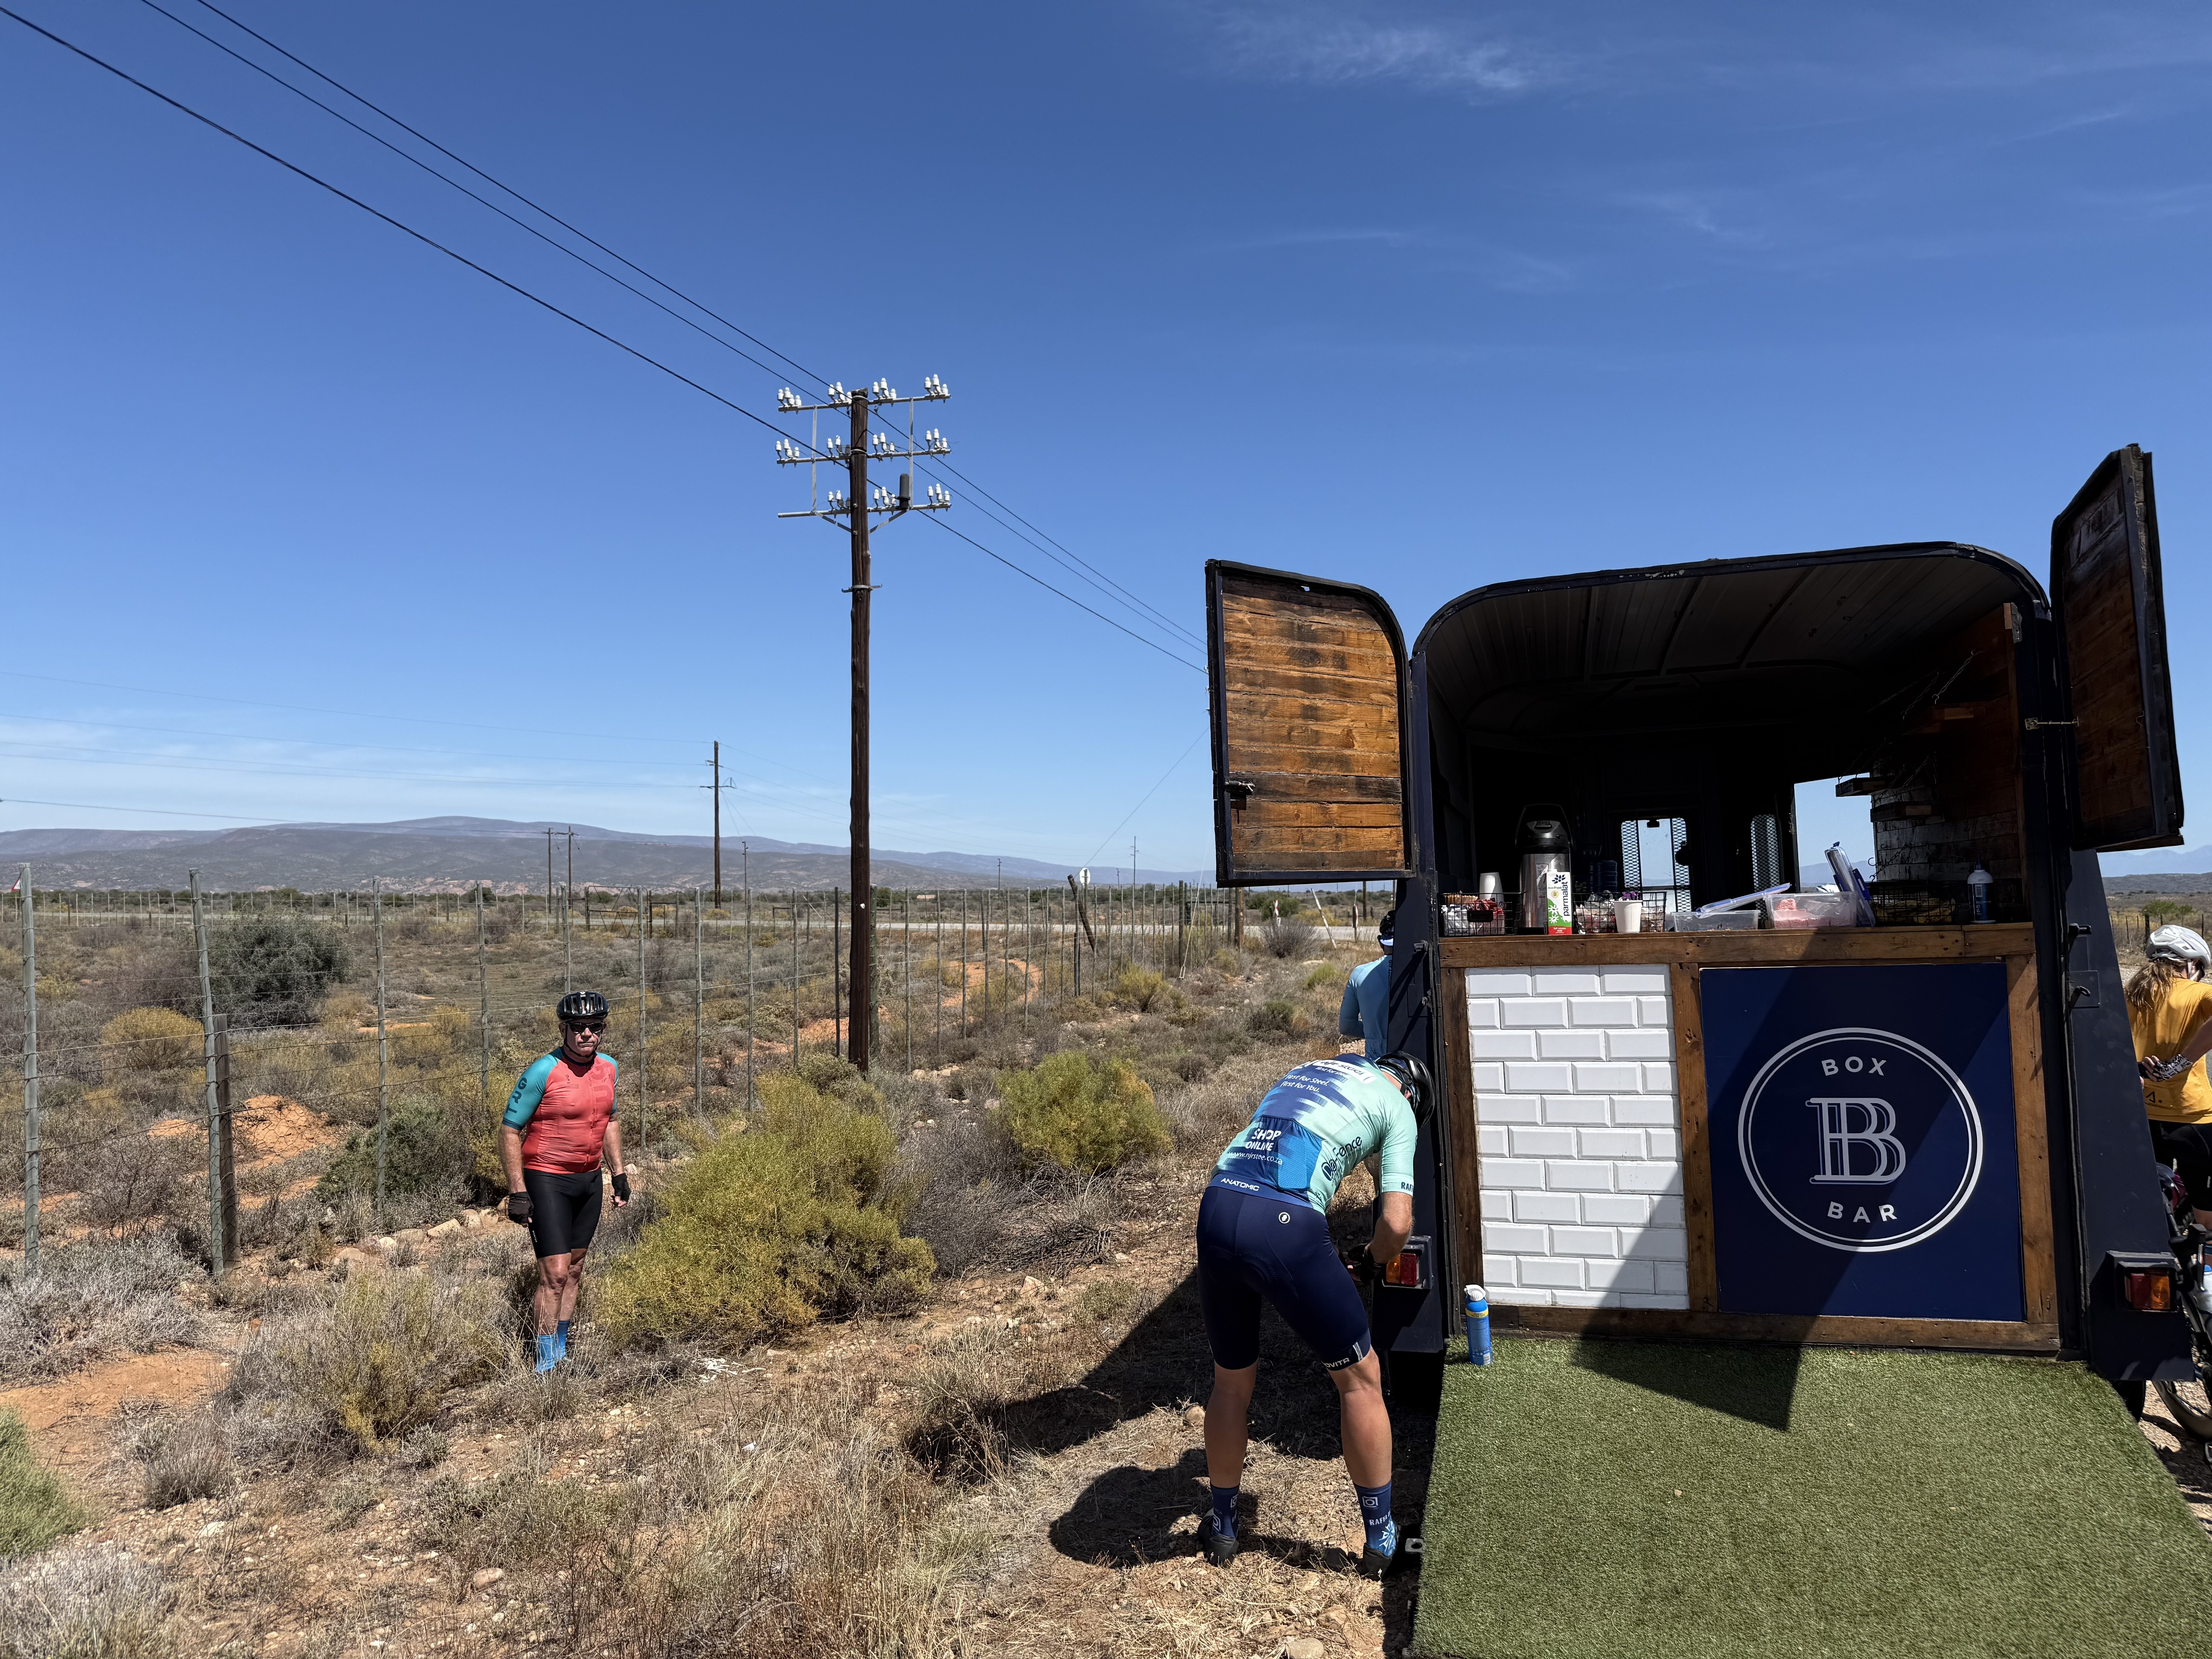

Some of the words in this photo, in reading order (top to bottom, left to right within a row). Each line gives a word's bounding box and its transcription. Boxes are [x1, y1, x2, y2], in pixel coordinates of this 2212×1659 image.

[1561, 881, 1570, 916] parmalat
[1821, 1056, 1886, 1076] BOX
[1310, 1078, 1330, 1086] Steel.
[506, 1077, 527, 1114] GRT
[1252, 1128, 1282, 1140] SHOP
[1245, 1141, 1274, 1151] ONLINE
[1221, 1178, 1260, 1191] ANATOMIC
[1827, 1201, 1898, 1223] BAR
